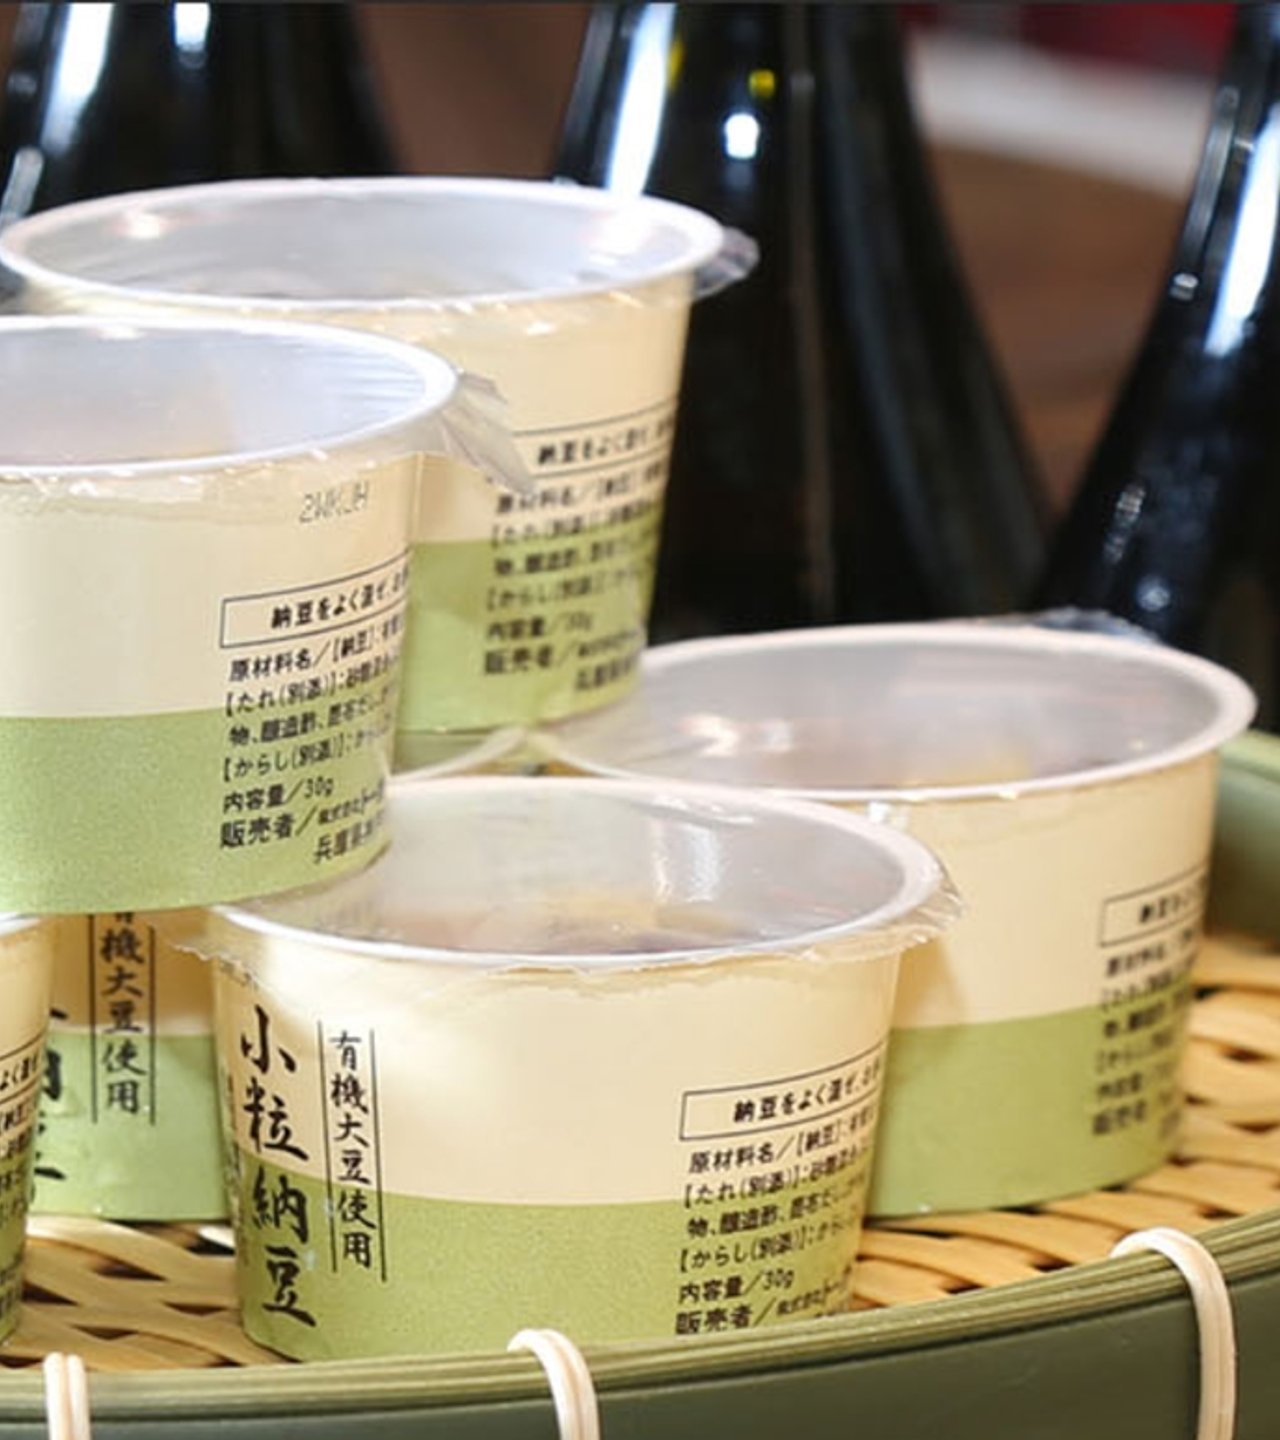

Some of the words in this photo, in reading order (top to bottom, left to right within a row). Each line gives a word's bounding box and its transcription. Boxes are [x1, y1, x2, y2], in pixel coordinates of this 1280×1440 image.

[241, 1005, 316, 1327] 小粒納豆
[330, 1031, 378, 1269] 有機大豆使用
